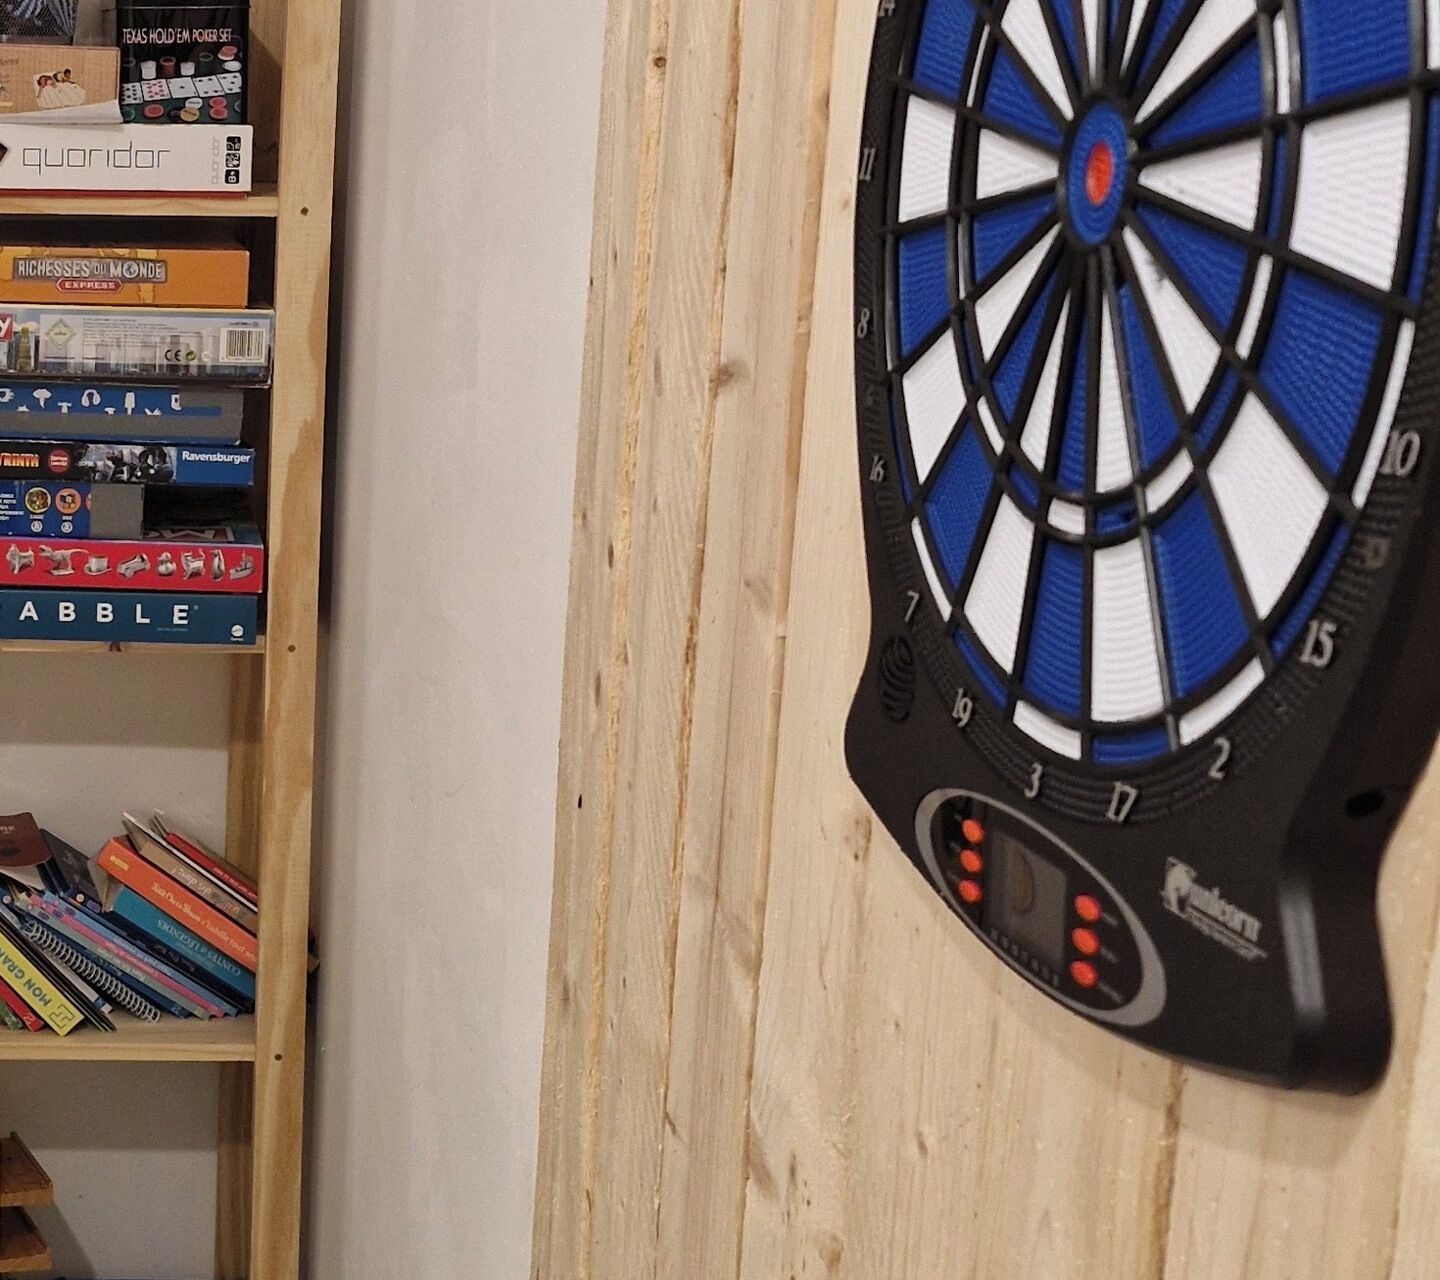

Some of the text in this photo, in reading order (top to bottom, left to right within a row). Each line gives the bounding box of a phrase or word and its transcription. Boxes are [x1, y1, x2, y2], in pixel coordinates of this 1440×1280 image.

[123, 27, 232, 44] TEXAS HOLD'EM POKER SET
[22, 140, 171, 176] quoridor
[859, 147, 877, 181] 11
[18, 260, 90, 278] RICHESSES
[110, 263, 162, 279] MONDE
[65, 280, 115, 290] EXPRESS
[857, 307, 870, 338] 8
[181, 450, 251, 464] Ravensburger
[870, 454, 886, 483] 16
[1380, 429, 1421, 477] 10
[905, 590, 920, 622] 7
[1299, 620, 1337, 668] 15
[952, 687, 972, 728] 19
[1209, 736, 1231, 780] 2
[1024, 762, 1043, 799] 3
[1105, 781, 1138, 824] 17
[22, 975, 53, 1009] MON
